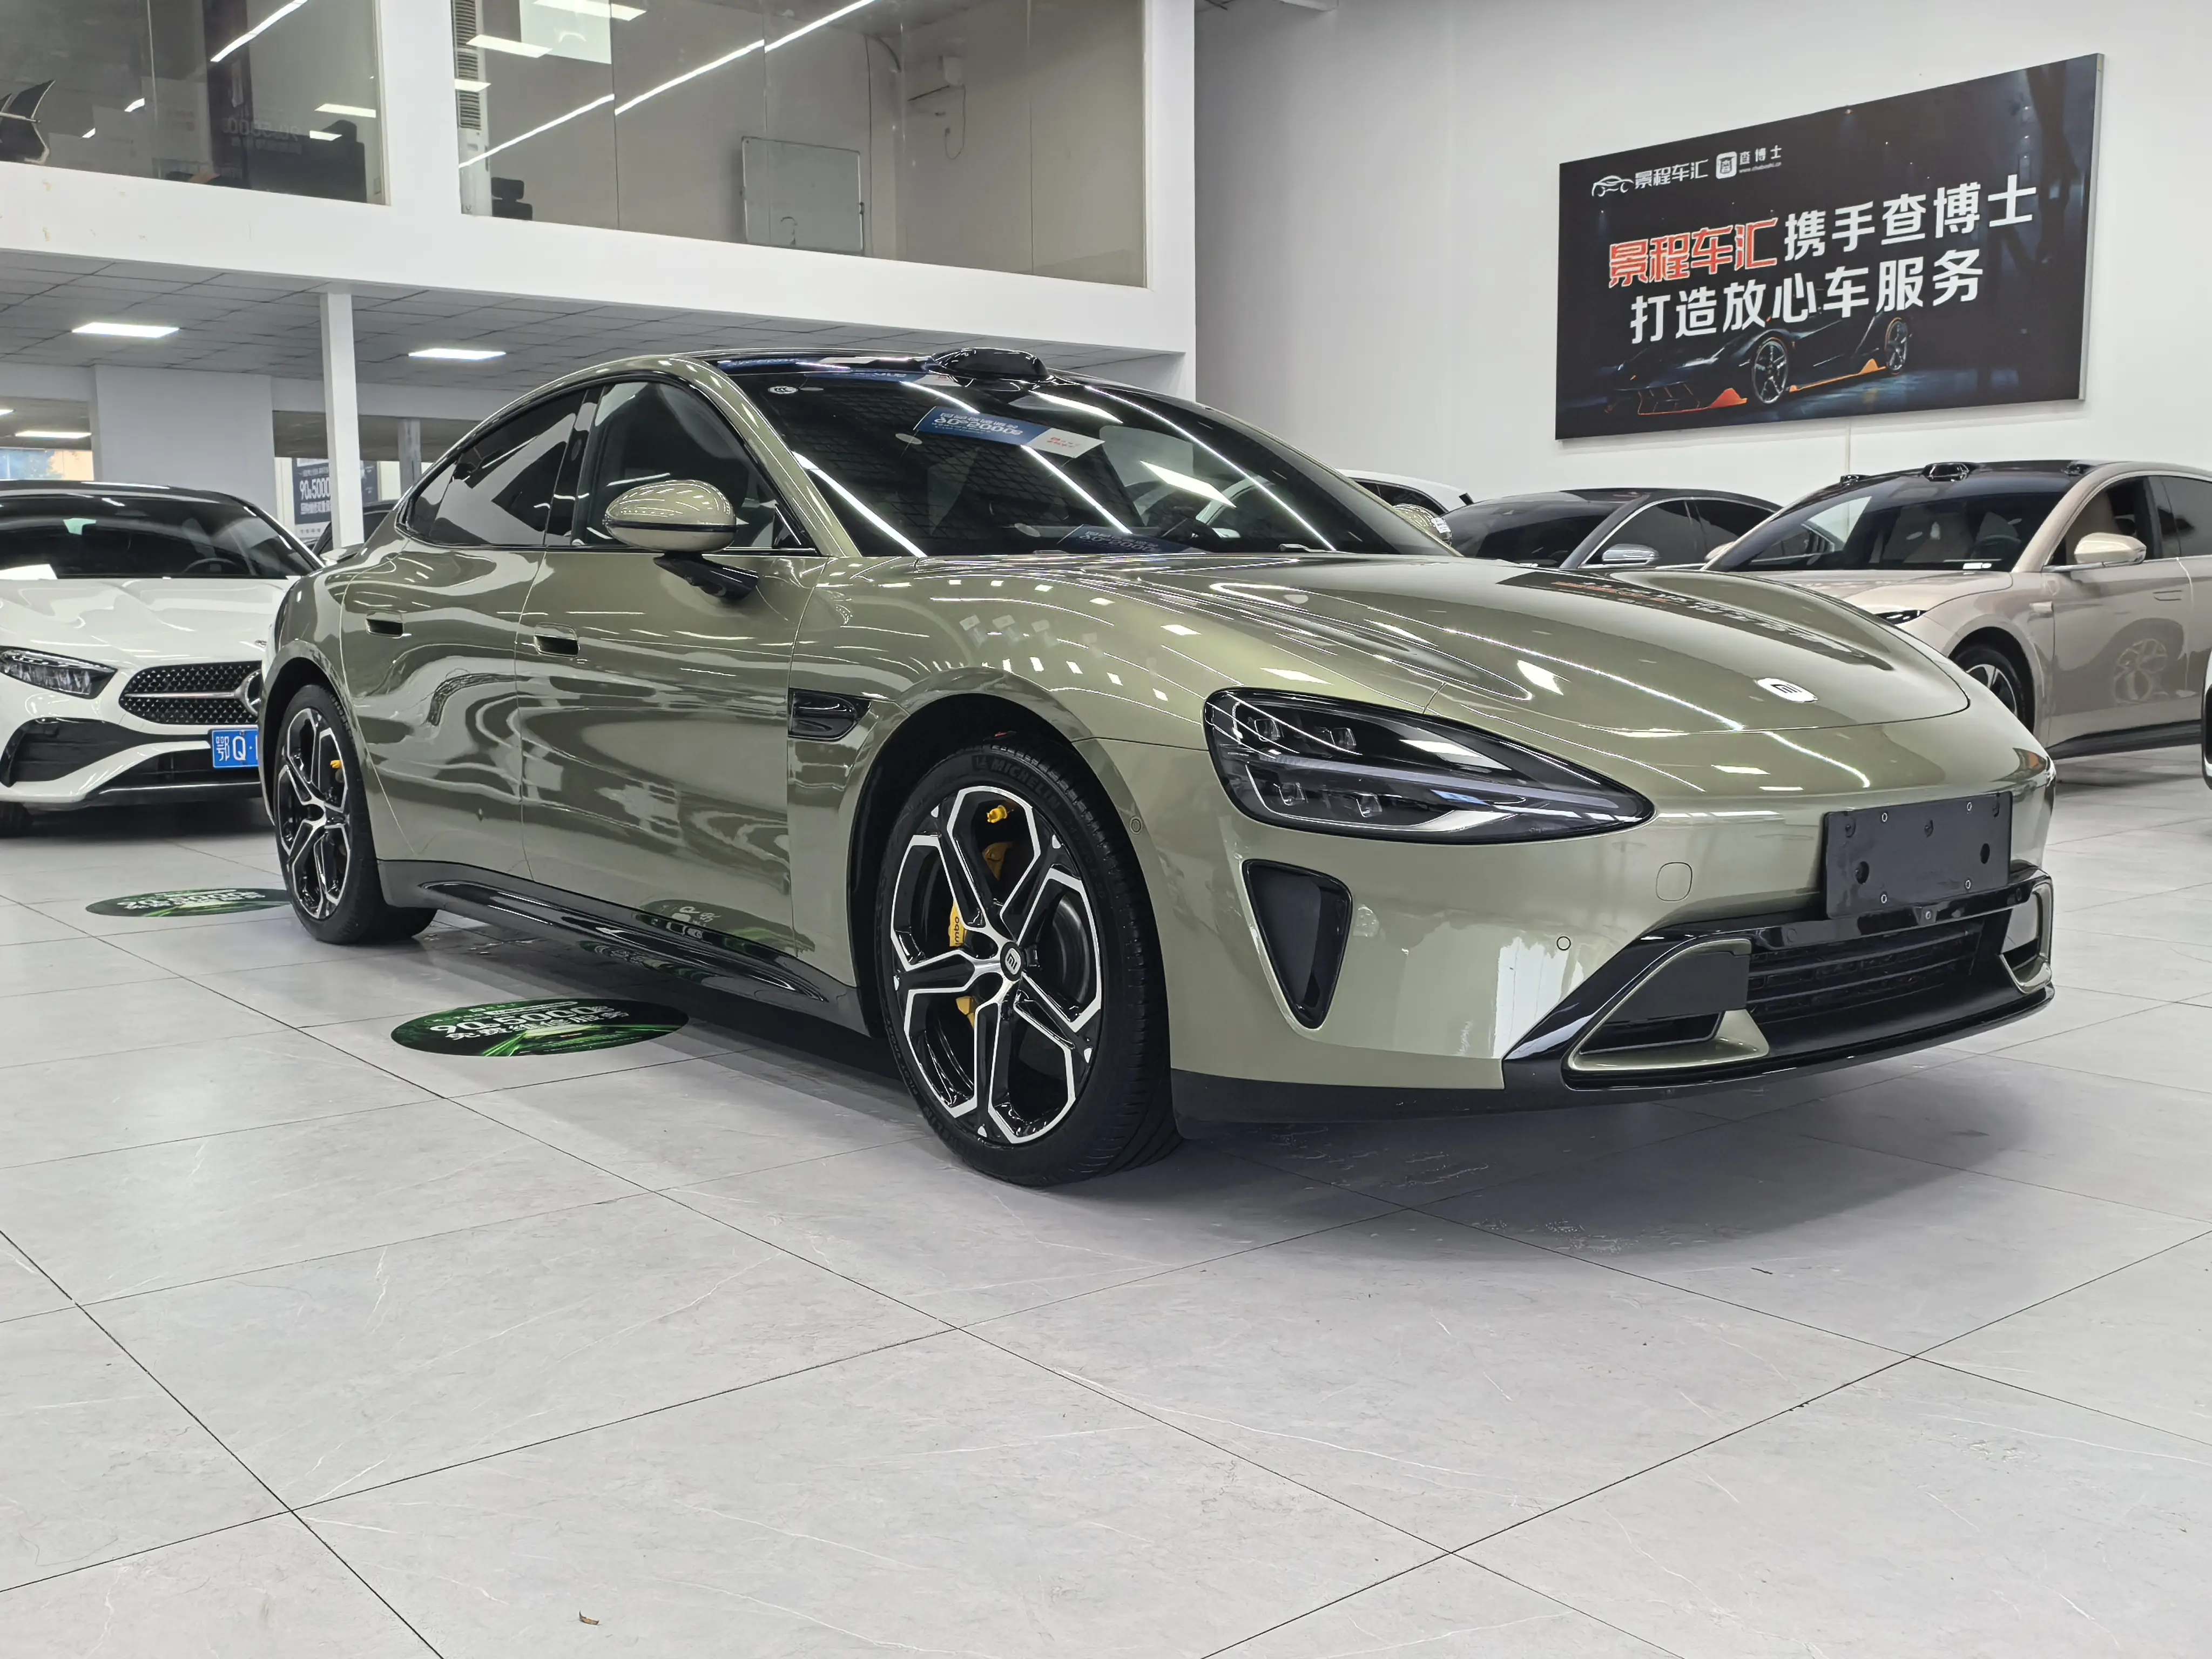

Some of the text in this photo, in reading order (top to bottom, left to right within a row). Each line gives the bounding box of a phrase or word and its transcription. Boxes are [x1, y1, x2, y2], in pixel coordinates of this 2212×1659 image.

[1635, 159, 1709, 190] 景程车汇
[1739, 145, 1782, 165] 查博士
[1608, 174, 2037, 288] 景程车汇 携手查博士
[1630, 248, 1984, 345] 打造放心车服务
[990, 757, 1061, 809] MICHELIN
